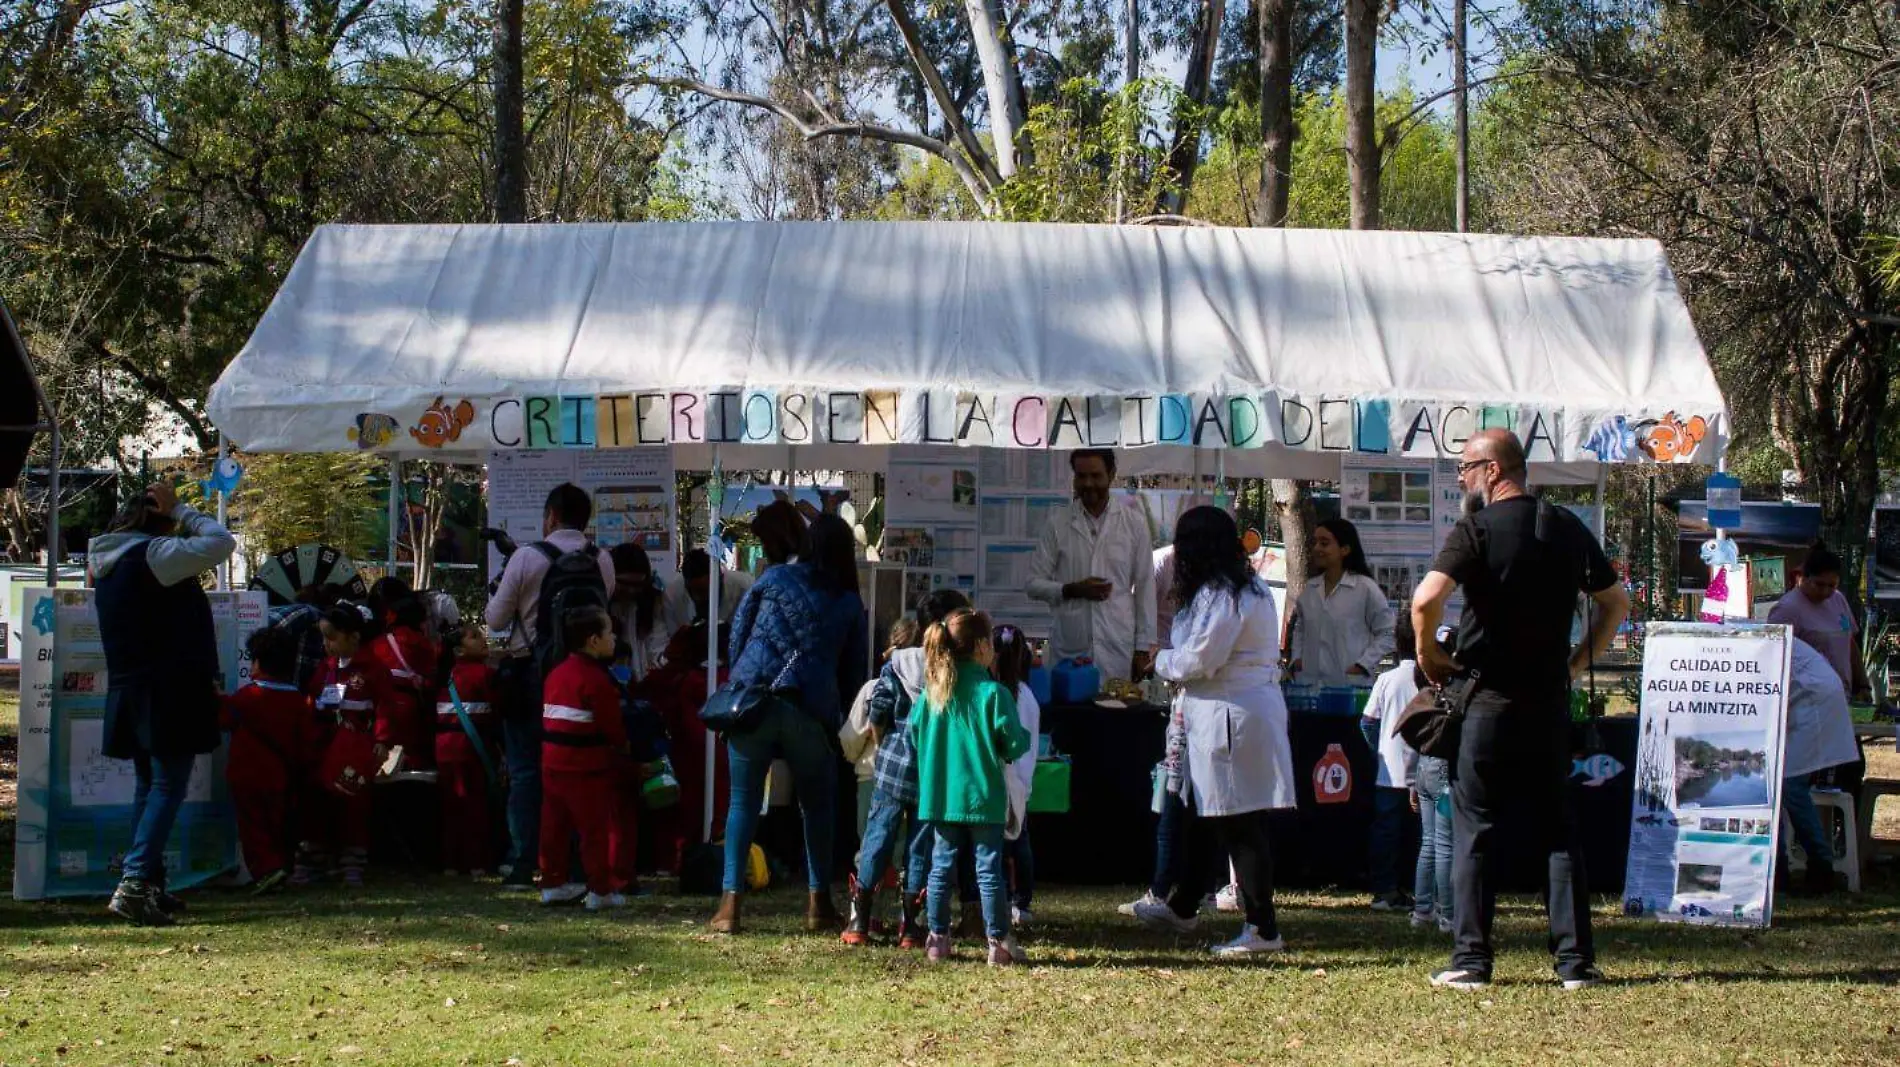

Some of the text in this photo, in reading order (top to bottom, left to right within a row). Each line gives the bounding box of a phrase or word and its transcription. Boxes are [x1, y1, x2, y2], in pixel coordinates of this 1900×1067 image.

[490, 392, 808, 447] CRITERIOS
[828, 391, 898, 445] EN
[923, 390, 995, 443] LA
[1011, 396, 1260, 447] CALIDAD
[1281, 398, 1389, 454] DEL
[1670, 659, 1761, 674] CALIDAD DEL
[1647, 679, 1782, 695] AGUA DE LA PRESA
[1667, 700, 1757, 716] LA MINTZITA
